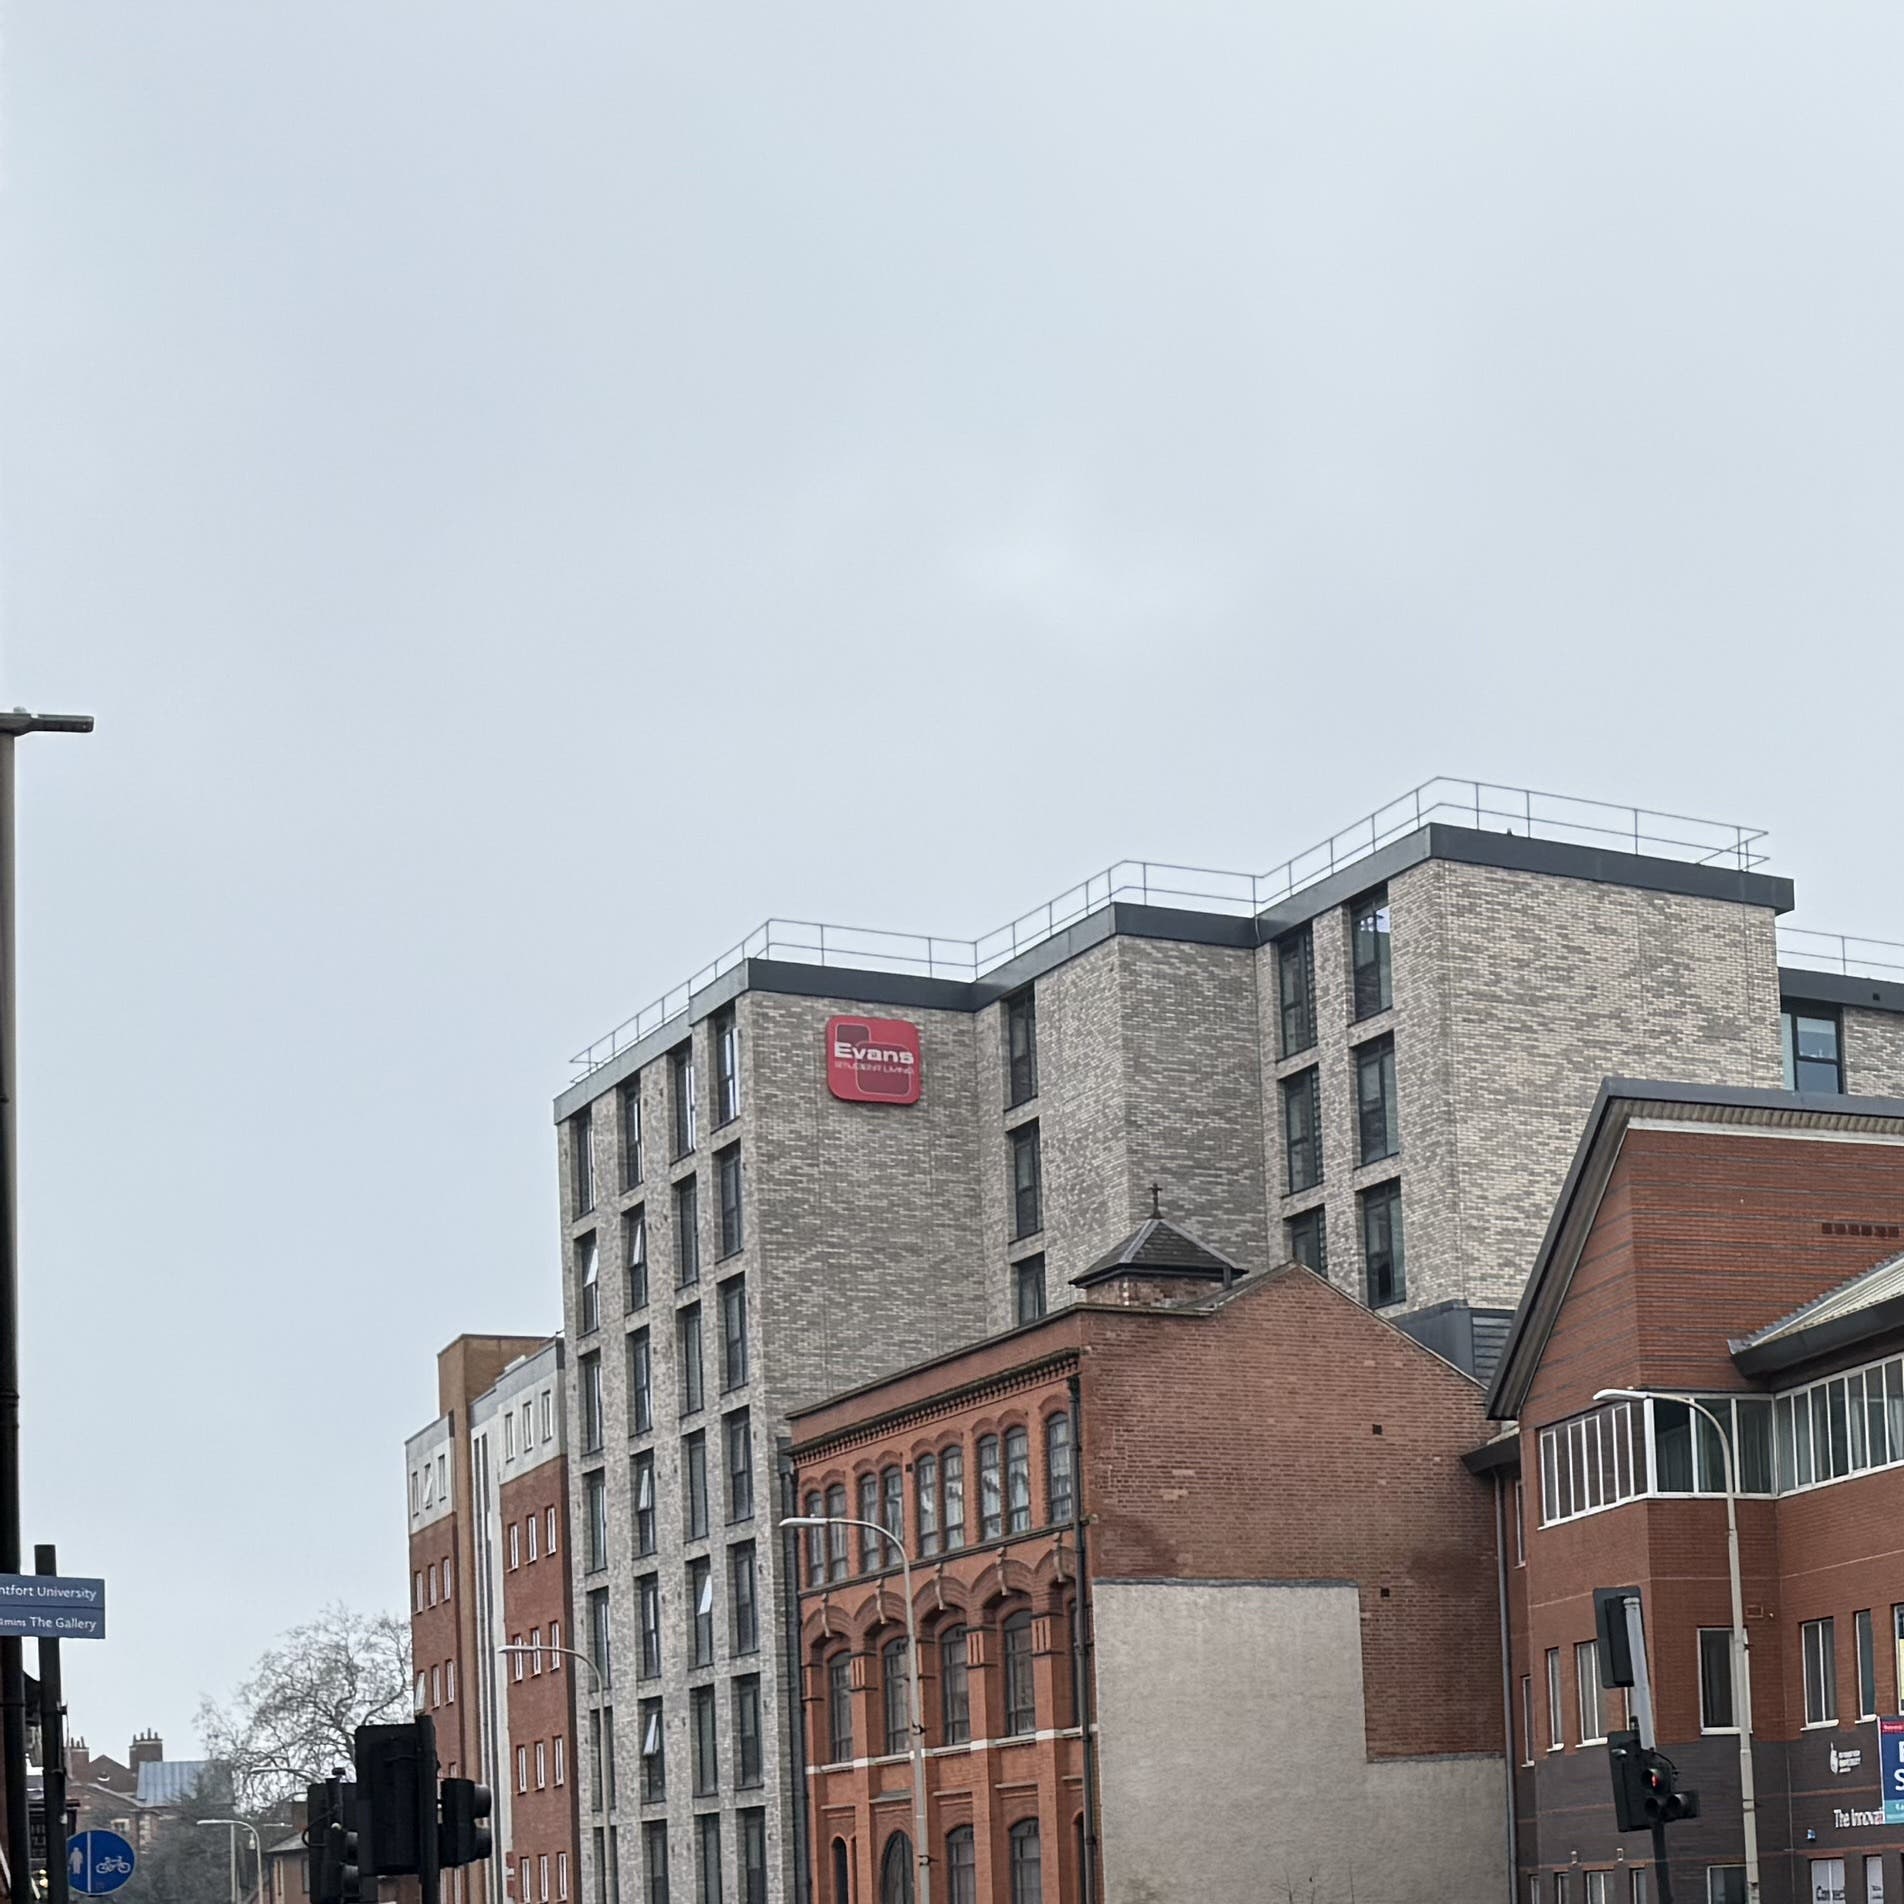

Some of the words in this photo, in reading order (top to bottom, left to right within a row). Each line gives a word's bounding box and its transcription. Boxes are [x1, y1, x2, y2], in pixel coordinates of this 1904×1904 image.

[834, 1041, 915, 1064] Evans
[37, 1585, 97, 1602] University
[29, 1616, 53, 1628] The
[55, 1616, 97, 1632] Gallery
[1833, 1808, 1850, 1828] The
